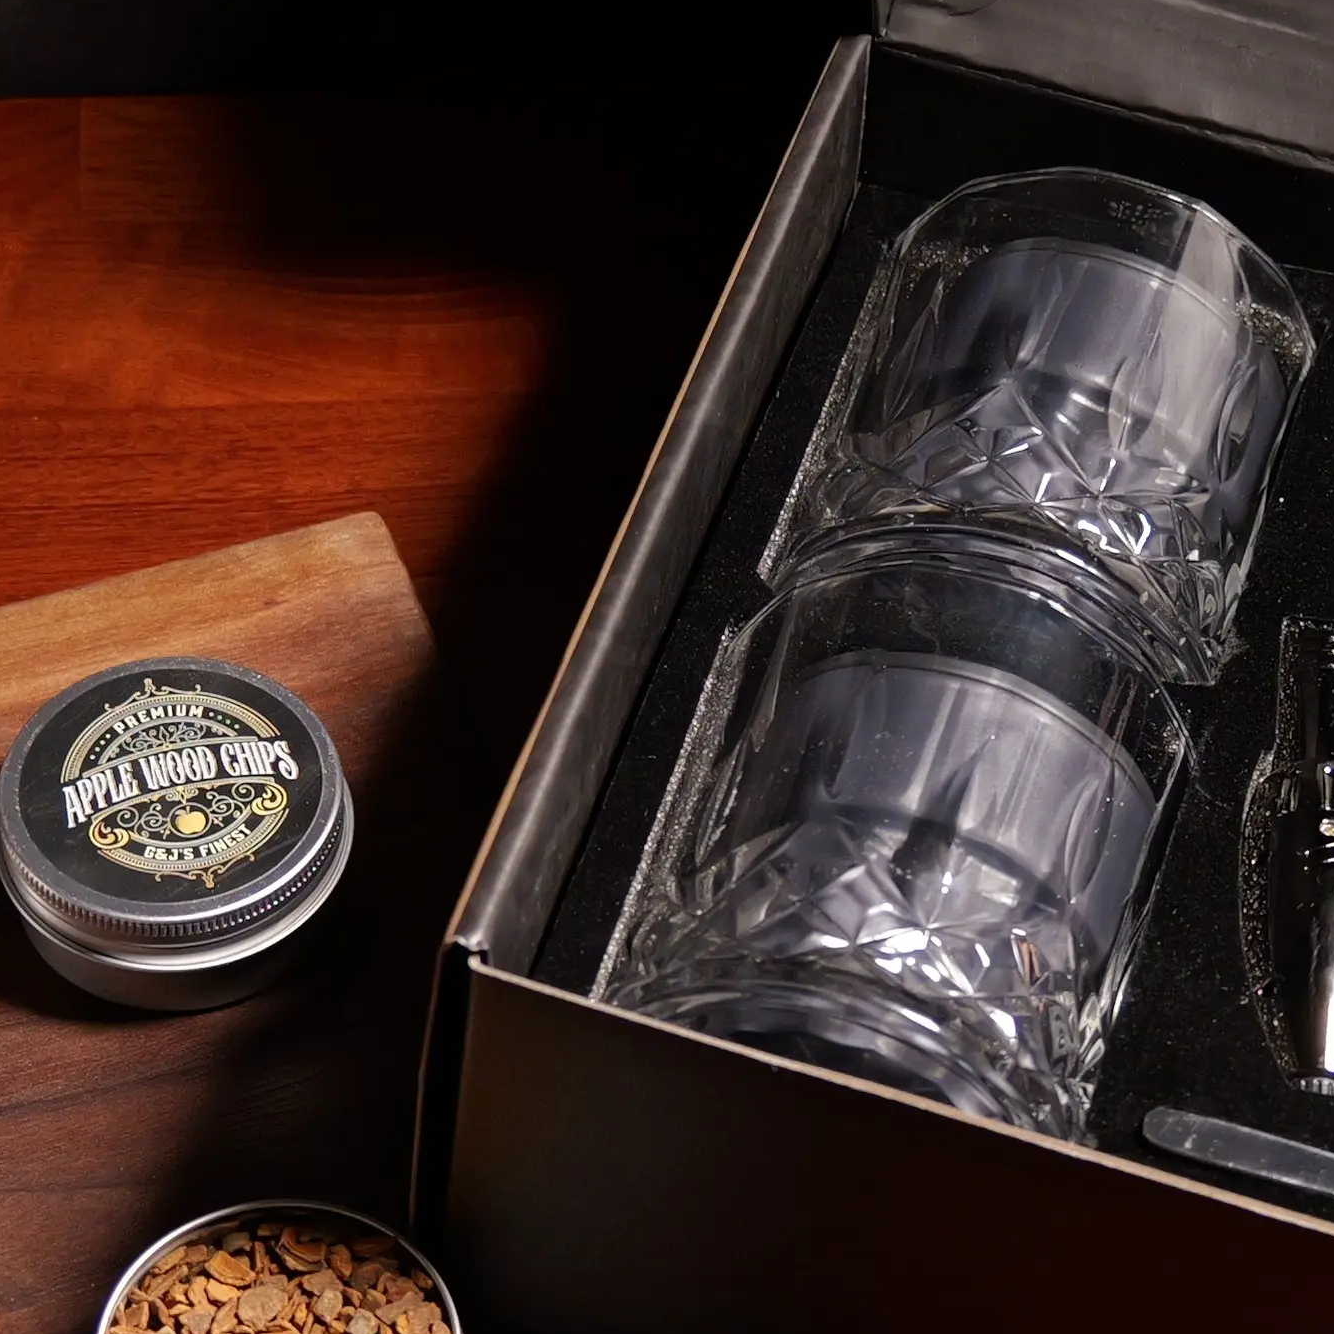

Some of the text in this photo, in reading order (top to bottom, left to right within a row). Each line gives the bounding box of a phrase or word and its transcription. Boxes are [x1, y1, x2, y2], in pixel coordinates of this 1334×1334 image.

[112, 704, 204, 736] PREMIUM
[62, 739, 300, 829] APPLE WOOD CHIPS
[143, 823, 252, 861] G&J'S FINEST
